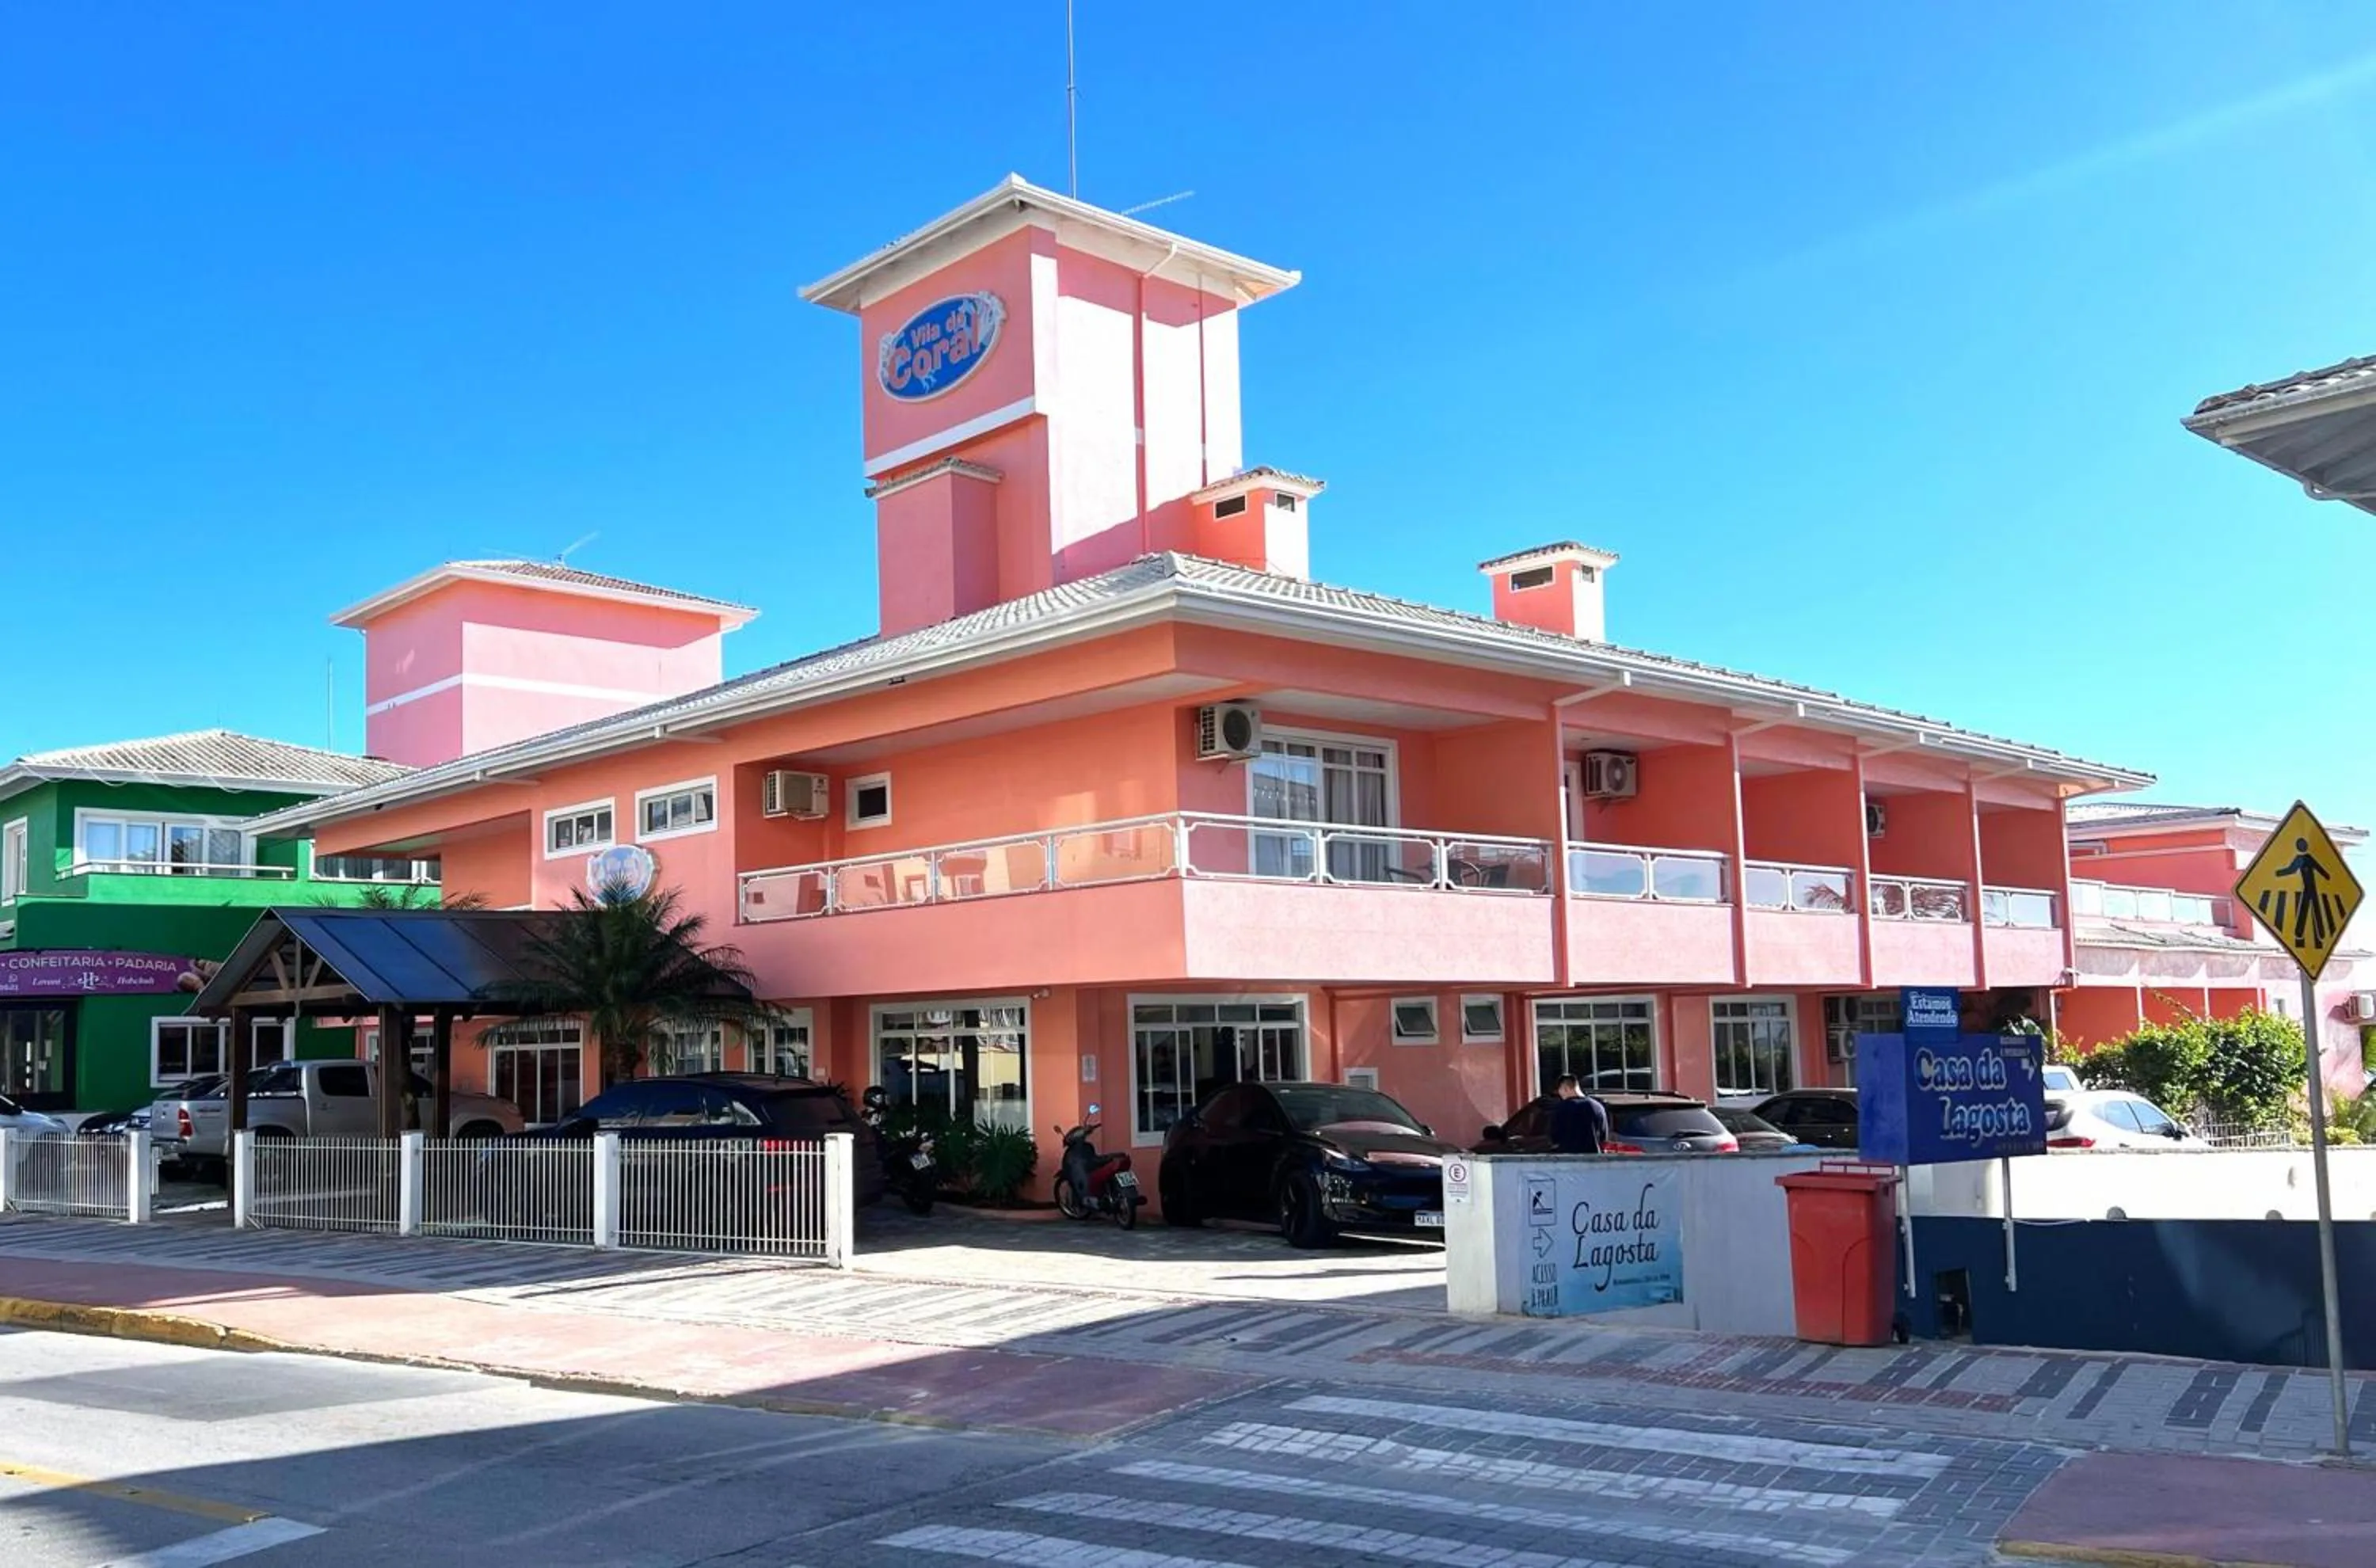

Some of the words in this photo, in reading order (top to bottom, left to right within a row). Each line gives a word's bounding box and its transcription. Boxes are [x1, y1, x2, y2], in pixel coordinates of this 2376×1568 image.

[887, 310, 980, 390] Coral
[911, 322, 940, 348] Vila
[9, 955, 105, 969] CONFEITARIA
[115, 957, 177, 972] PADARIA
[1907, 1009, 1958, 1026] Atendendo
[1910, 991, 1951, 1010] Estamos
[1913, 1047, 1974, 1091] Casa
[1976, 1047, 2007, 1090] da
[1939, 1095, 2031, 1148] Lagosta
[1572, 1201, 1629, 1235] Casa
[1632, 1182, 1661, 1230] da
[1572, 1232, 1660, 1292] Lagosta
